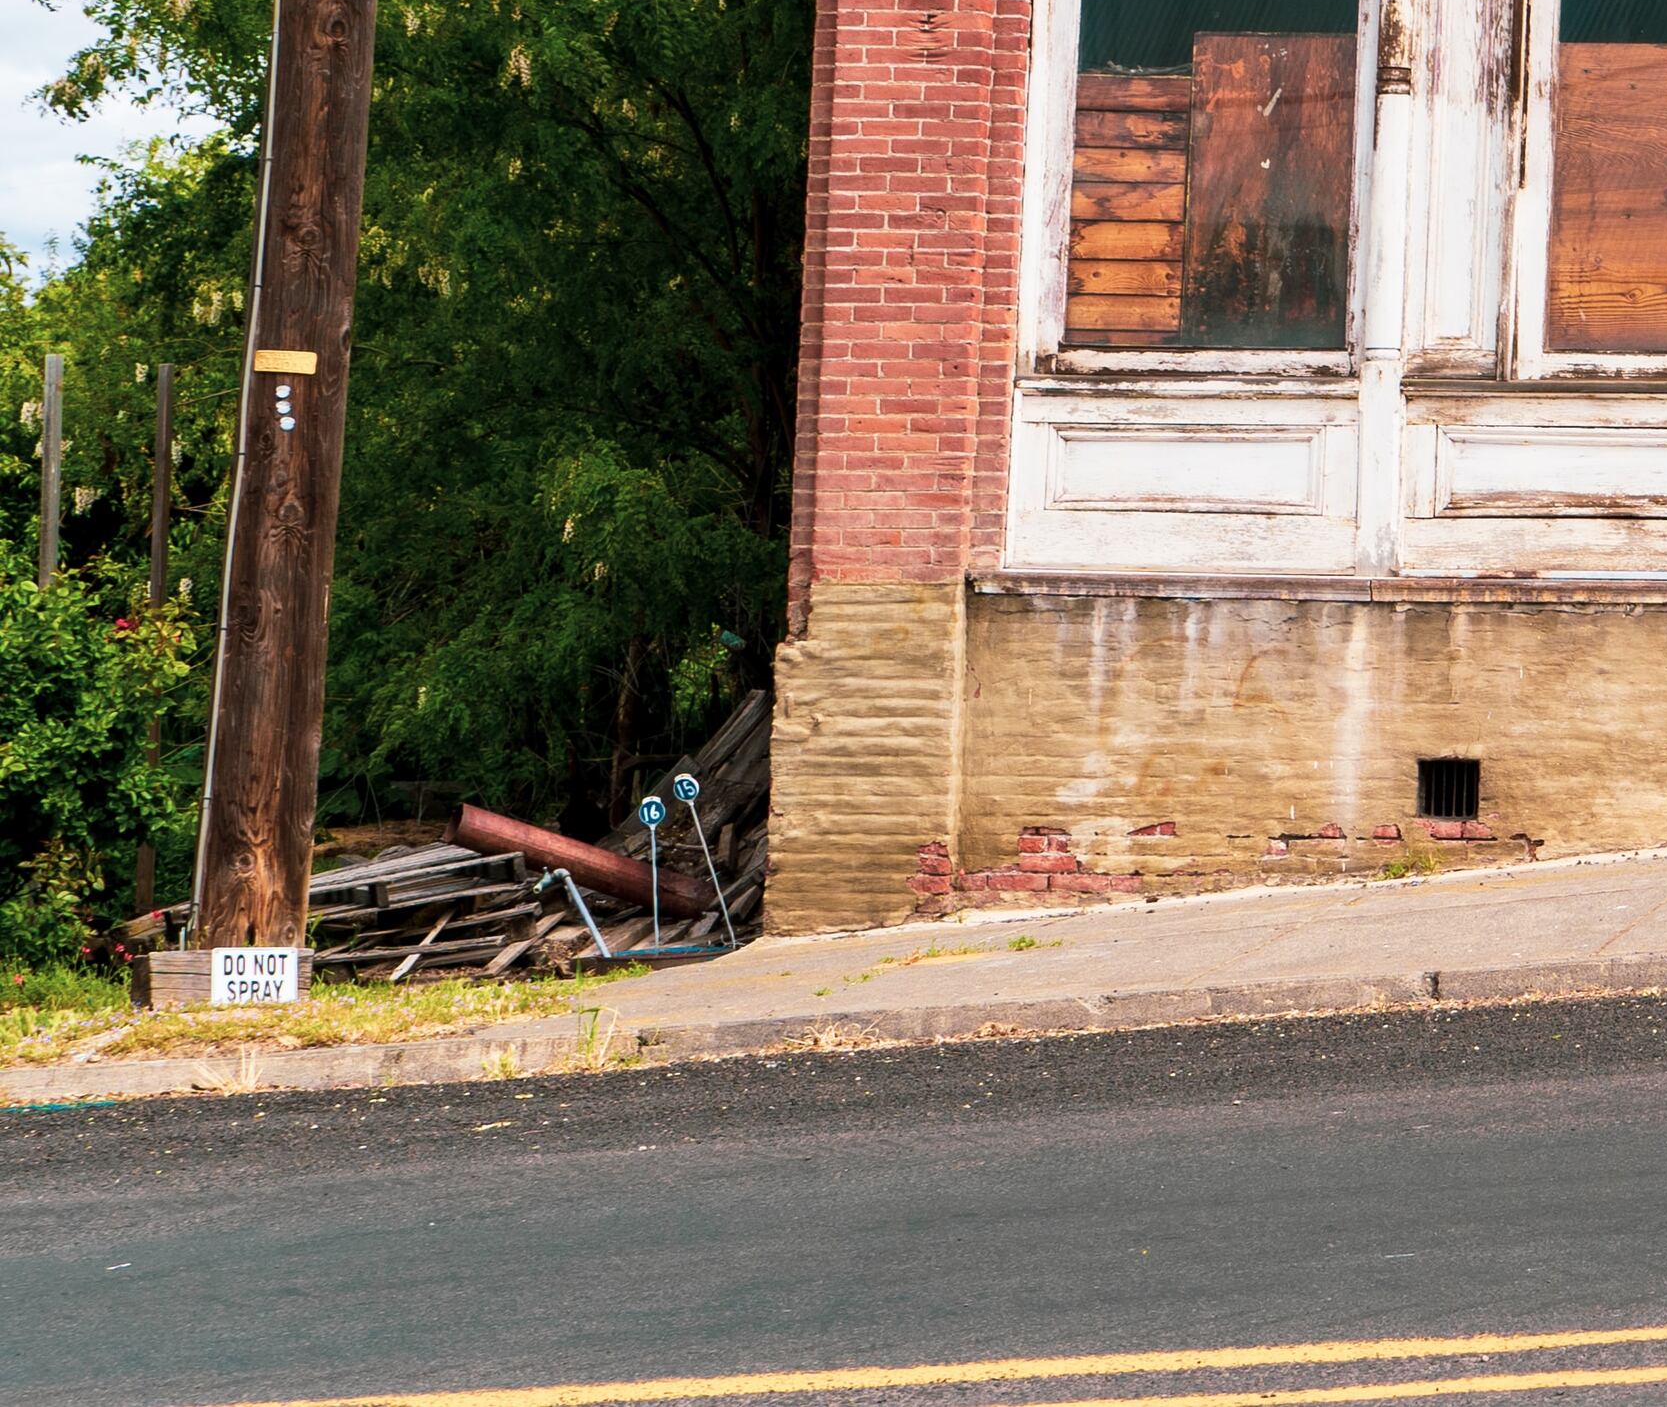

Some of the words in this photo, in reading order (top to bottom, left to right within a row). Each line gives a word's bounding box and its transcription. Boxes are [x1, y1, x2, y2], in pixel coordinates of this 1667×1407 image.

[676, 781, 697, 798] 15
[643, 804, 660, 822] 16
[224, 954, 245, 975] DO
[254, 954, 288, 975] NOT
[227, 980, 283, 1002] SPRAY
